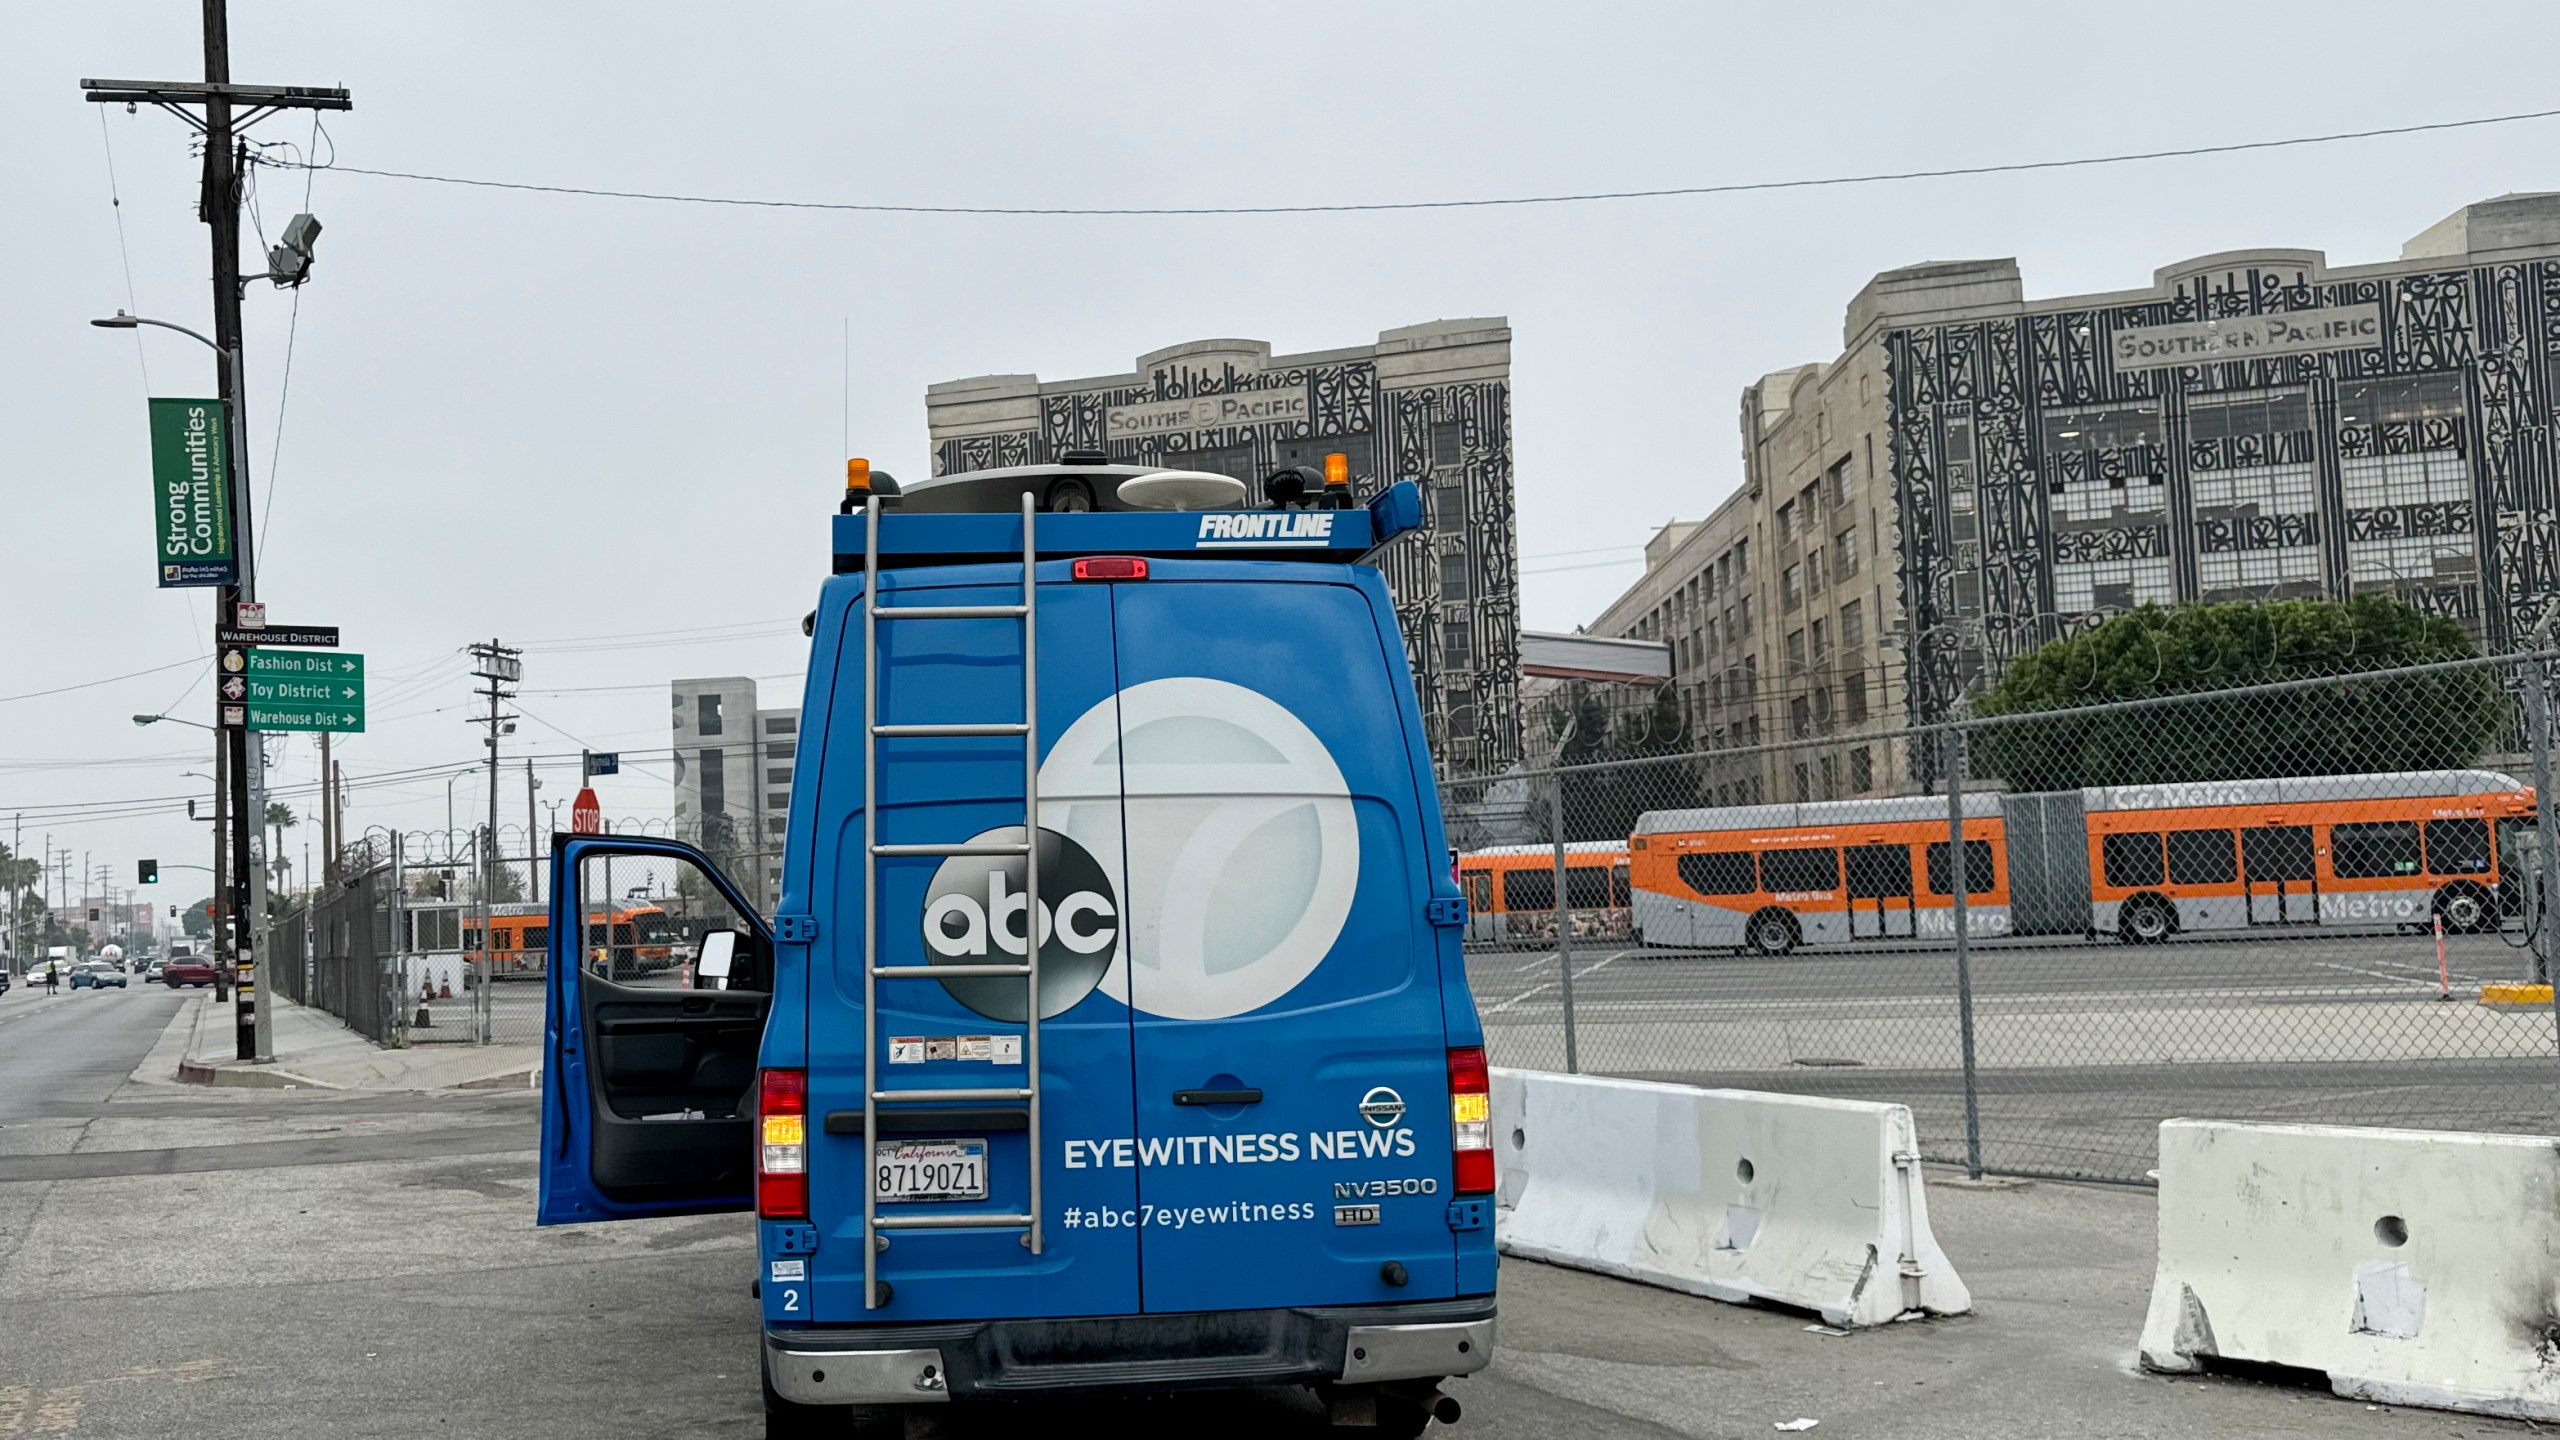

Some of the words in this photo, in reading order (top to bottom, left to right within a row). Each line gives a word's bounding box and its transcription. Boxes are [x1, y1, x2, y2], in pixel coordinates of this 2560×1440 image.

[2267, 317, 2377, 345] PACIFIC
[1221, 398, 1305, 418] PACIFIC
[183, 406, 213, 555] Communities
[166, 480, 190, 556] Strong
[1198, 513, 1335, 539] FRONTLINE
[221, 631, 288, 642] WAREHOUSE
[290, 632, 338, 644] DISTRICT
[250, 655, 302, 671] Fashion
[306, 658, 333, 672] Dist
[251, 683, 274, 699] Toy
[278, 683, 331, 699] District
[251, 710, 312, 725] Warehouse
[315, 712, 338, 726] Dist
[574, 808, 599, 833] STOP
[923, 869, 1116, 956] abc
[2319, 893, 2414, 919] Metro
[1364, 1104, 1402, 1112] NISSAN
[876, 1148, 890, 1157] OCT
[894, 1145, 964, 1163] California
[1064, 1132, 1300, 1169] EYEWITNESS
[1309, 1127, 1416, 1161] NEWS
[878, 1162, 980, 1193] 87190Z1
[1333, 1177, 1438, 1199] NV3500
[1063, 1200, 1315, 1230] #abc7eyewitness
[1342, 1208, 1374, 1223] HD
[783, 1288, 799, 1312] 2
